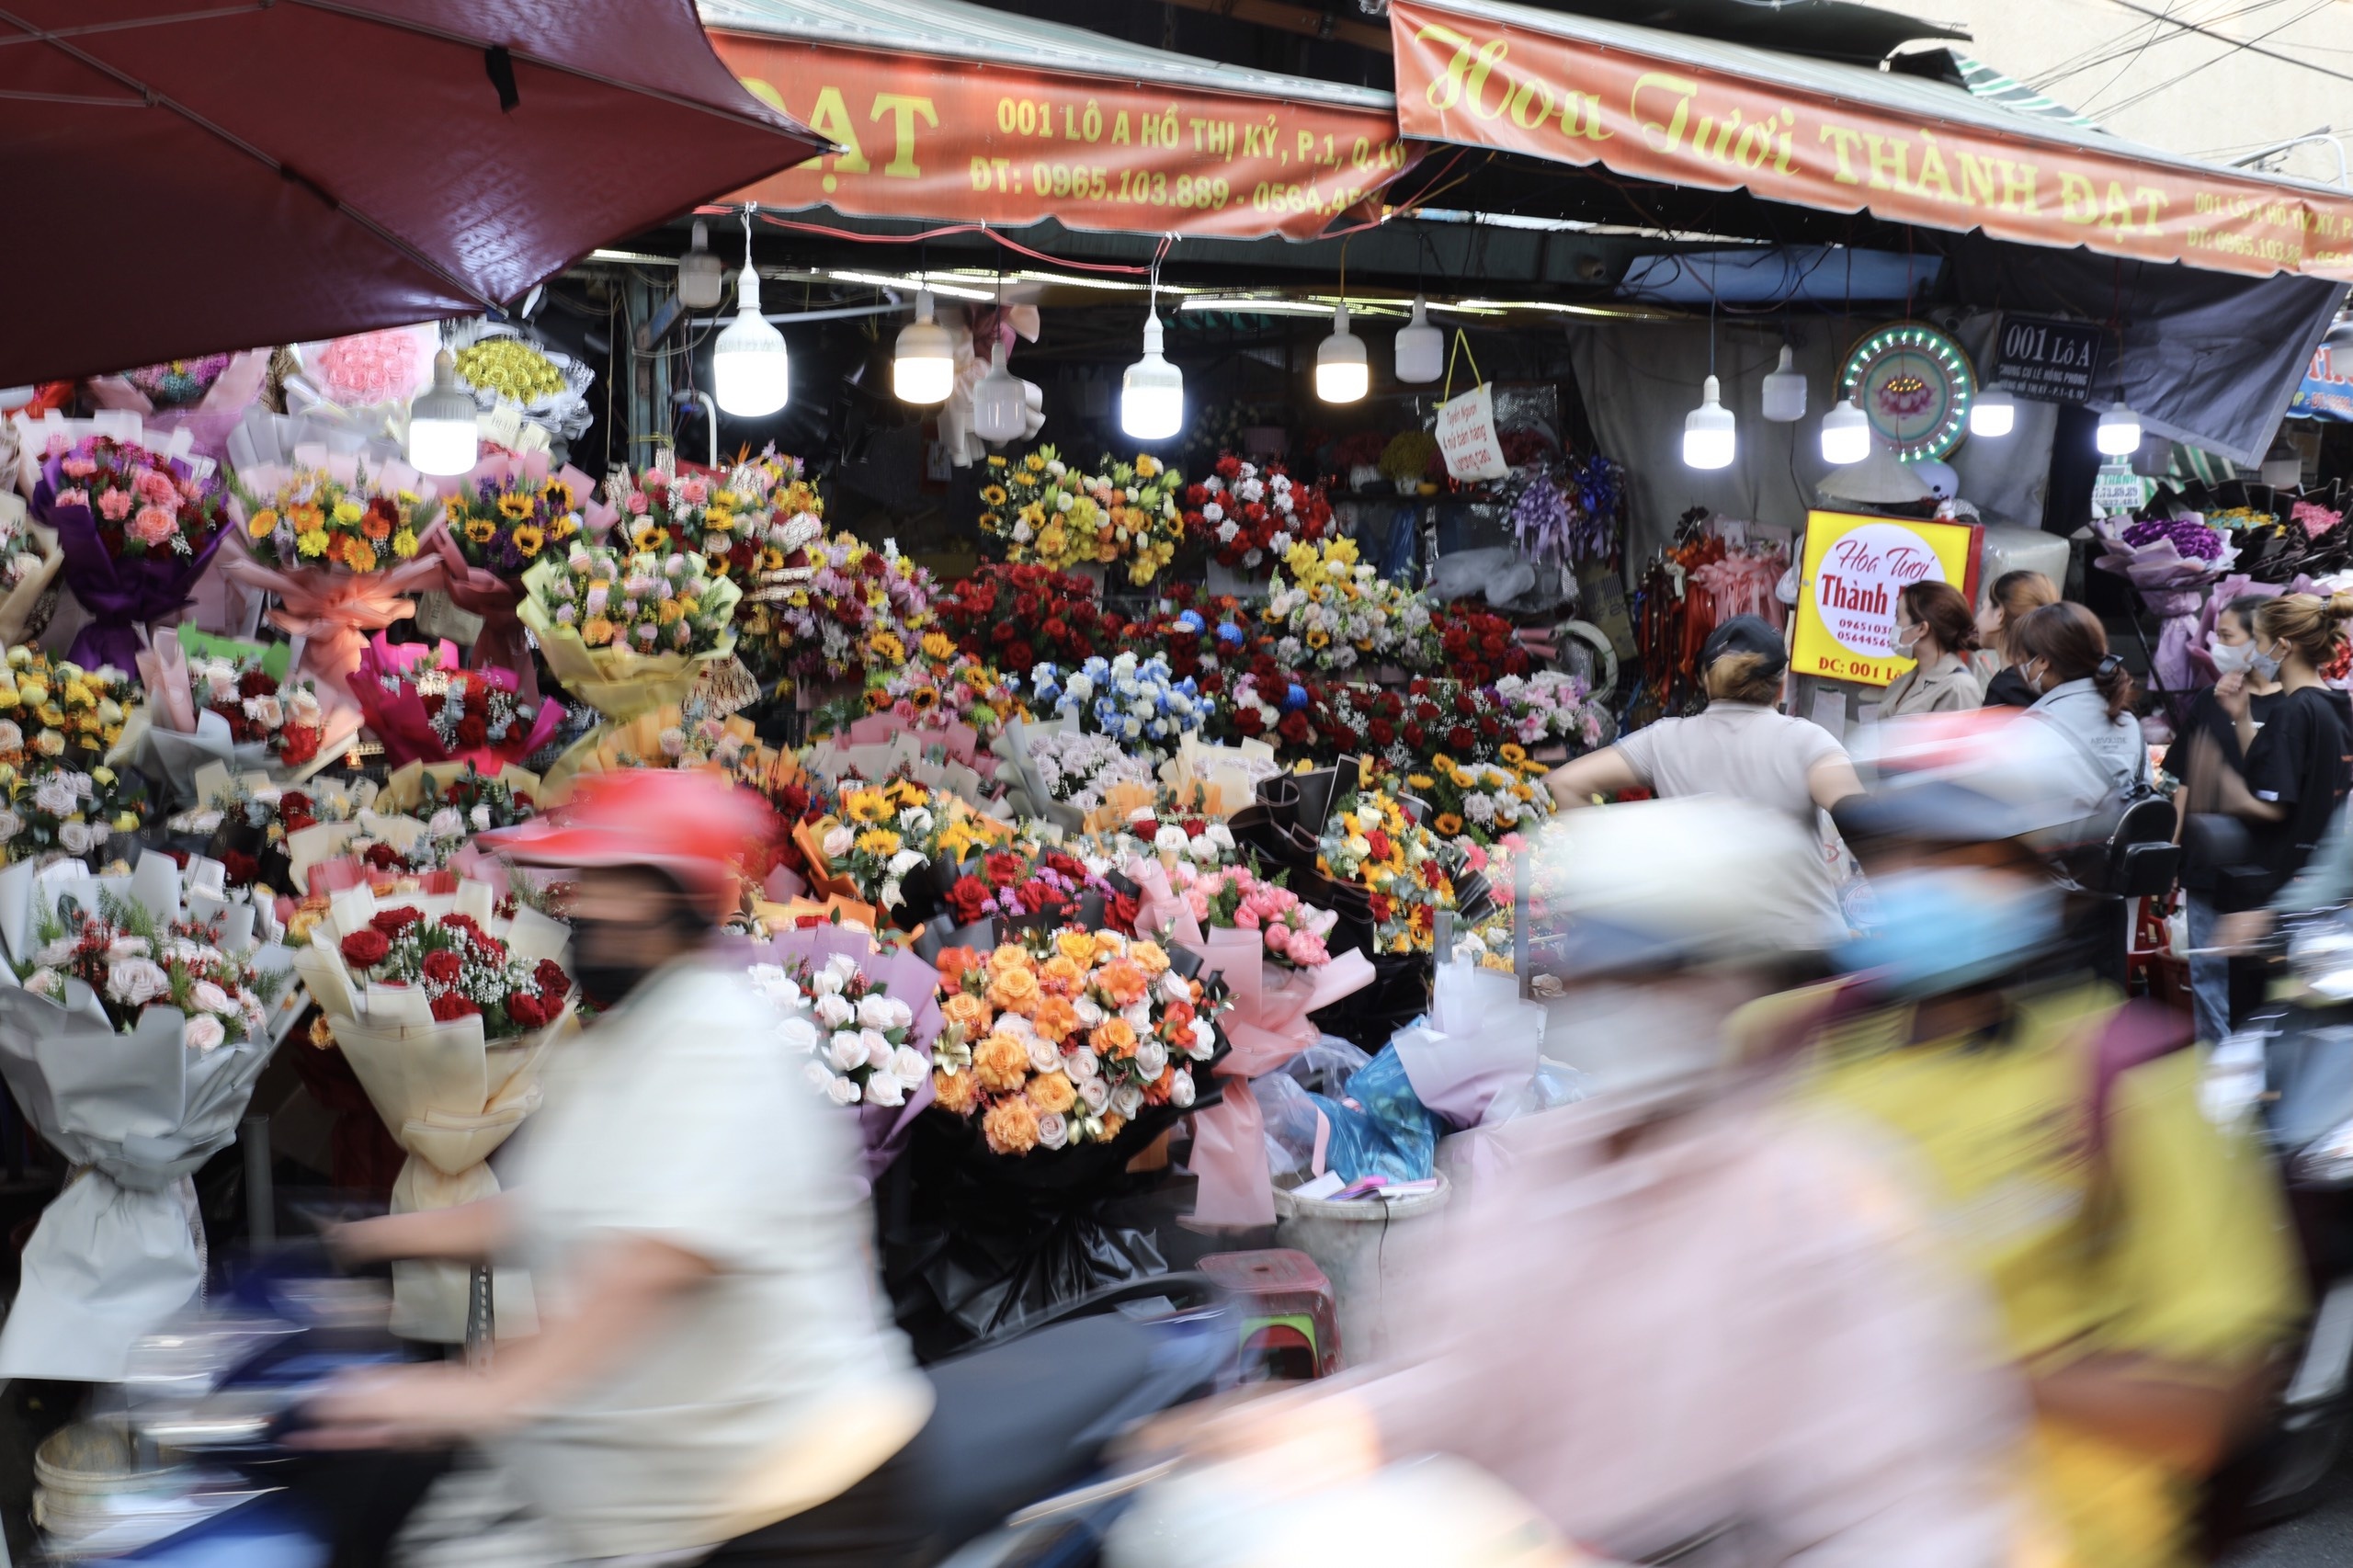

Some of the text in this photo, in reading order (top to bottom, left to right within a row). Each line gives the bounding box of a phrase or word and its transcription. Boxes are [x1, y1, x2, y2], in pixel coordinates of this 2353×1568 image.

[739, 76, 939, 194] ẠT
[997, 97, 1053, 138] 001
[1065, 97, 1103, 142] LÔ
[1111, 110, 1131, 146] A
[1189, 118, 1235, 163] THỊ
[1243, 114, 1289, 166] KỶ,
[1298, 130, 1343, 172] P.1,
[1352, 136, 1407, 174] Q.10
[1414, 23, 2169, 244] Hoa Tươi THÀNH ĐẠT
[970, 155, 1022, 194] ĐT:
[1033, 162, 1229, 210] 0965.103.889
[2195, 191, 2224, 215] 001
[2006, 324, 2089, 367] 001 Lô A
[2063, 372, 2088, 386] PHONG
[1836, 540, 1881, 574] Hoa
[1822, 574, 1888, 615] Thành
[1819, 656, 1844, 674] ĐC:
[1849, 662, 1879, 678] 001
